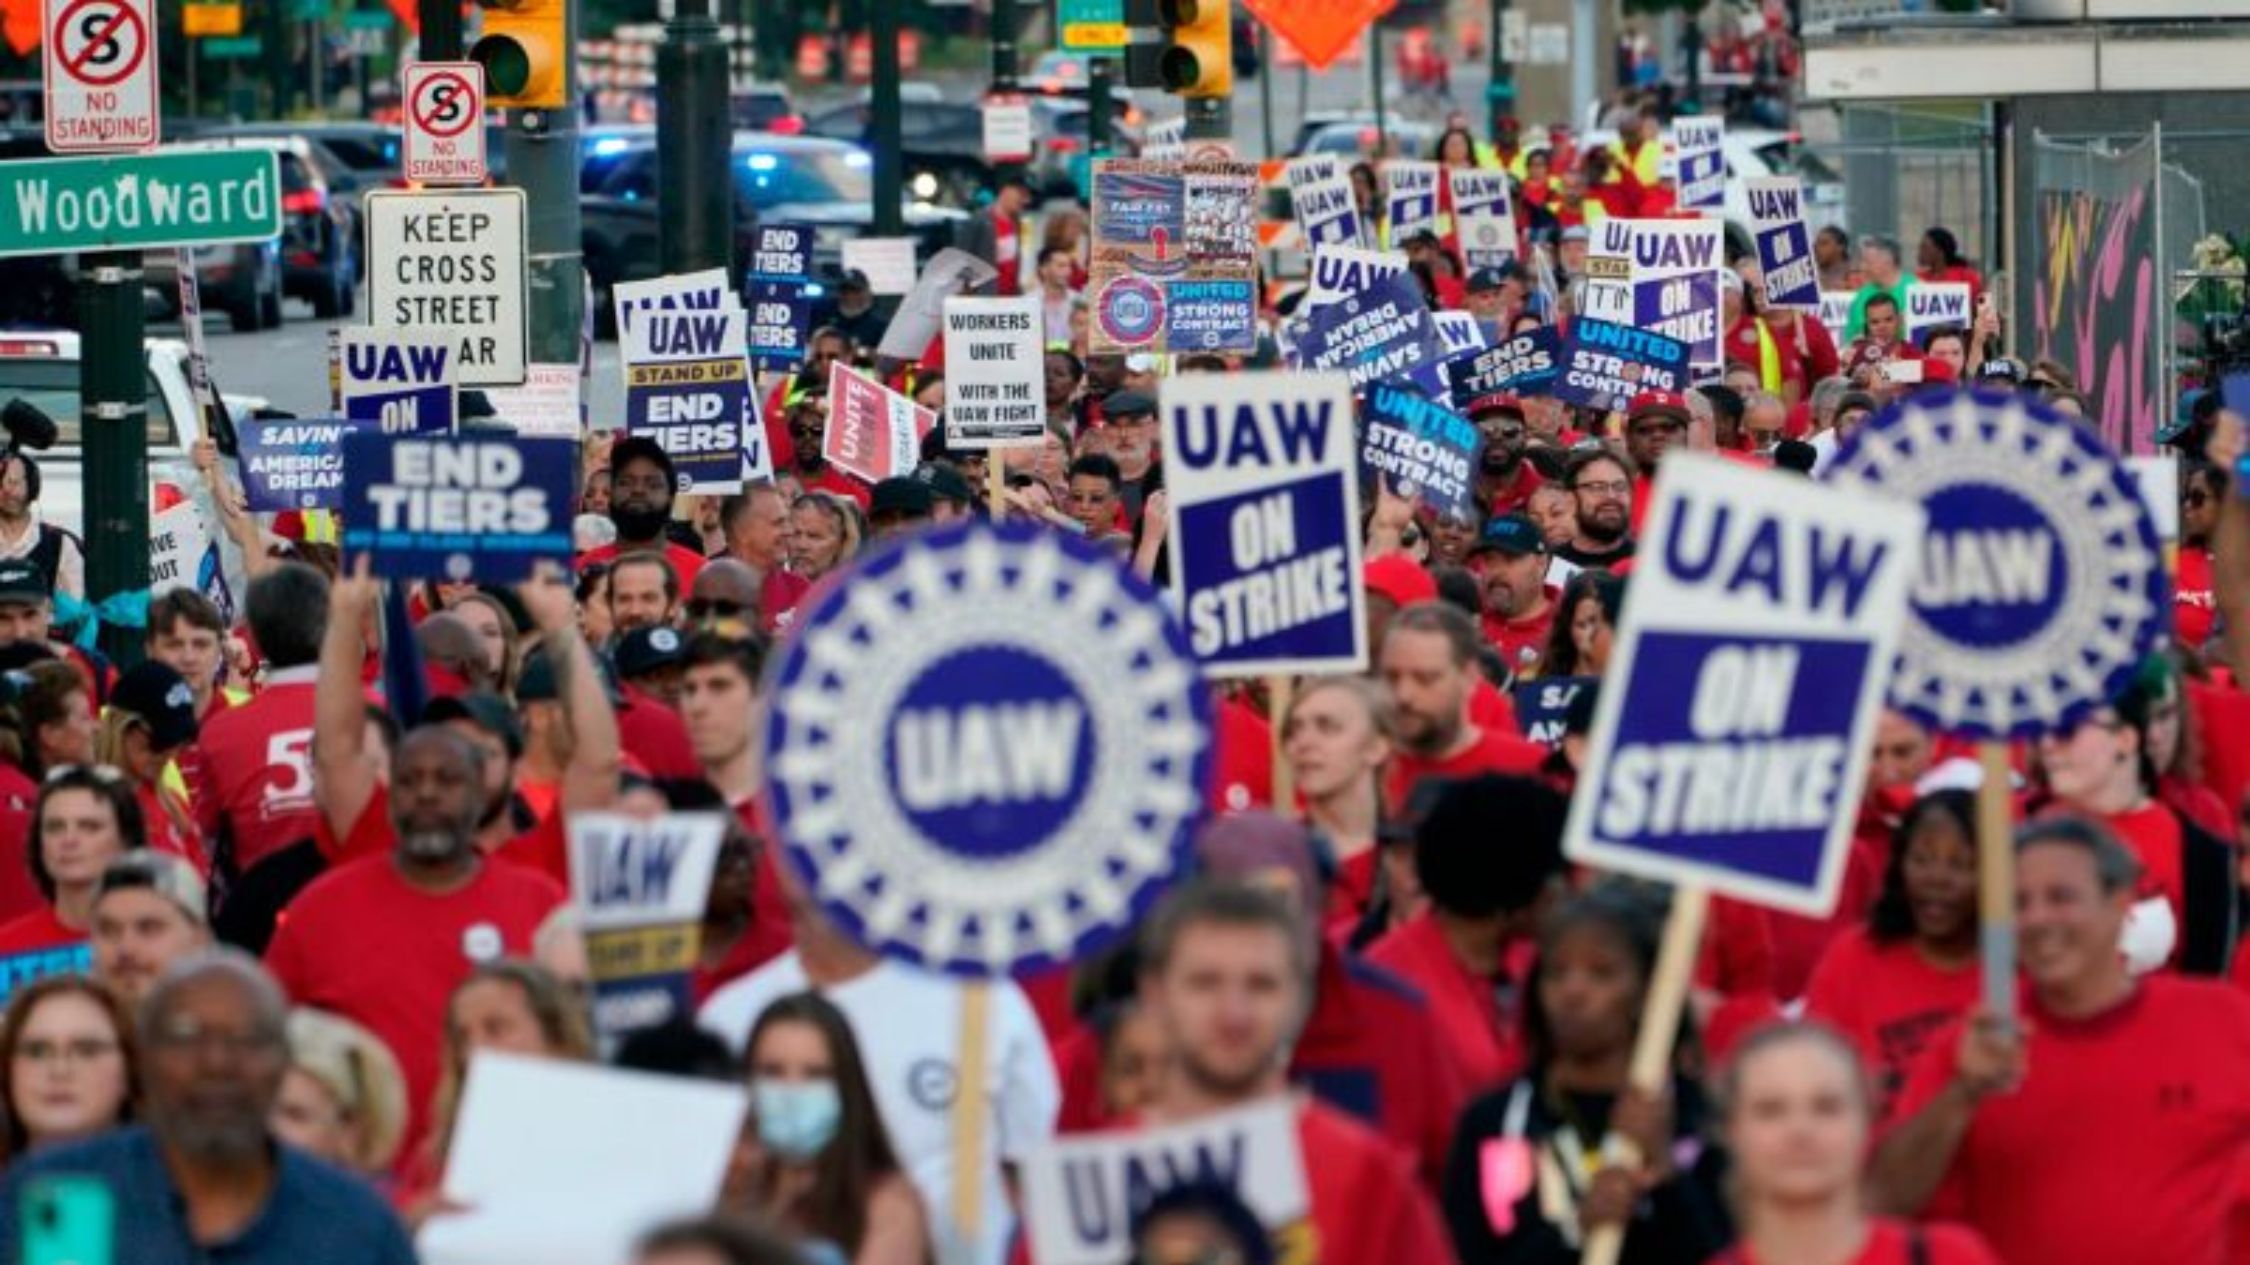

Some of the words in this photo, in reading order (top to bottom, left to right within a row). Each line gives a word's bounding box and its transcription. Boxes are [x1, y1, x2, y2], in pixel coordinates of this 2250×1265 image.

[86, 92, 116, 111] NO
[56, 117, 150, 138] STANDING
[1678, 127, 1719, 148] UAW
[432, 141, 456, 155] NO
[413, 160, 478, 175] STANDING
[1393, 171, 1432, 188] UAW
[15, 167, 268, 234] Woodward
[1301, 188, 1347, 213] UAW
[1454, 176, 1502, 196] UAW
[1750, 188, 1799, 219] UAW
[403, 213, 490, 242] KEEP
[762, 230, 798, 251] END
[754, 252, 804, 273] TIERS
[1636, 233, 1715, 267] UAW
[397, 255, 496, 284] CROSS
[1317, 256, 1399, 293] UAW
[1172, 283, 1247, 298] UNITED
[1660, 279, 1691, 316] ON
[1910, 294, 1964, 317] UAW
[395, 295, 500, 324] STREET
[756, 303, 791, 324] END
[950, 314, 1030, 330] WORKERS
[1171, 318, 1248, 330] CONTRACT
[1172, 302, 1248, 318] STRONG
[650, 315, 729, 354] UAW
[1315, 311, 1419, 372] AMERICAN
[1579, 320, 1681, 362] UNITED
[348, 343, 448, 383] UAW
[970, 343, 1016, 360] UNITE
[1351, 342, 1421, 386] SAVIN
[1473, 336, 1534, 376] END
[635, 365, 704, 383] STAND
[711, 362, 738, 378] UP
[1464, 350, 1553, 392] TIERS
[1566, 371, 1648, 398] CONTR
[959, 384, 998, 399] WITH
[1003, 383, 1030, 399] THE
[382, 396, 418, 433] ON
[647, 393, 723, 422] END
[840, 378, 867, 460] UNITE
[953, 405, 989, 422] UAW
[995, 404, 1037, 421] FIGHT
[1374, 387, 1479, 450] UNITED
[261, 425, 357, 446] SAVIN
[1174, 398, 1334, 471] UAW
[391, 441, 522, 488] END
[1367, 421, 1470, 484] STRONG
[1362, 448, 1467, 502] CONTRACT
[367, 486, 551, 534] TIERS
[1228, 491, 1297, 571] ON
[1664, 496, 1889, 619] UAW
[1188, 543, 1348, 657] STRIKE
[1690, 643, 1801, 740] ON
[898, 699, 1082, 812] UAW
[1600, 733, 1844, 839] STRIKE
[583, 831, 694, 911] UAW
